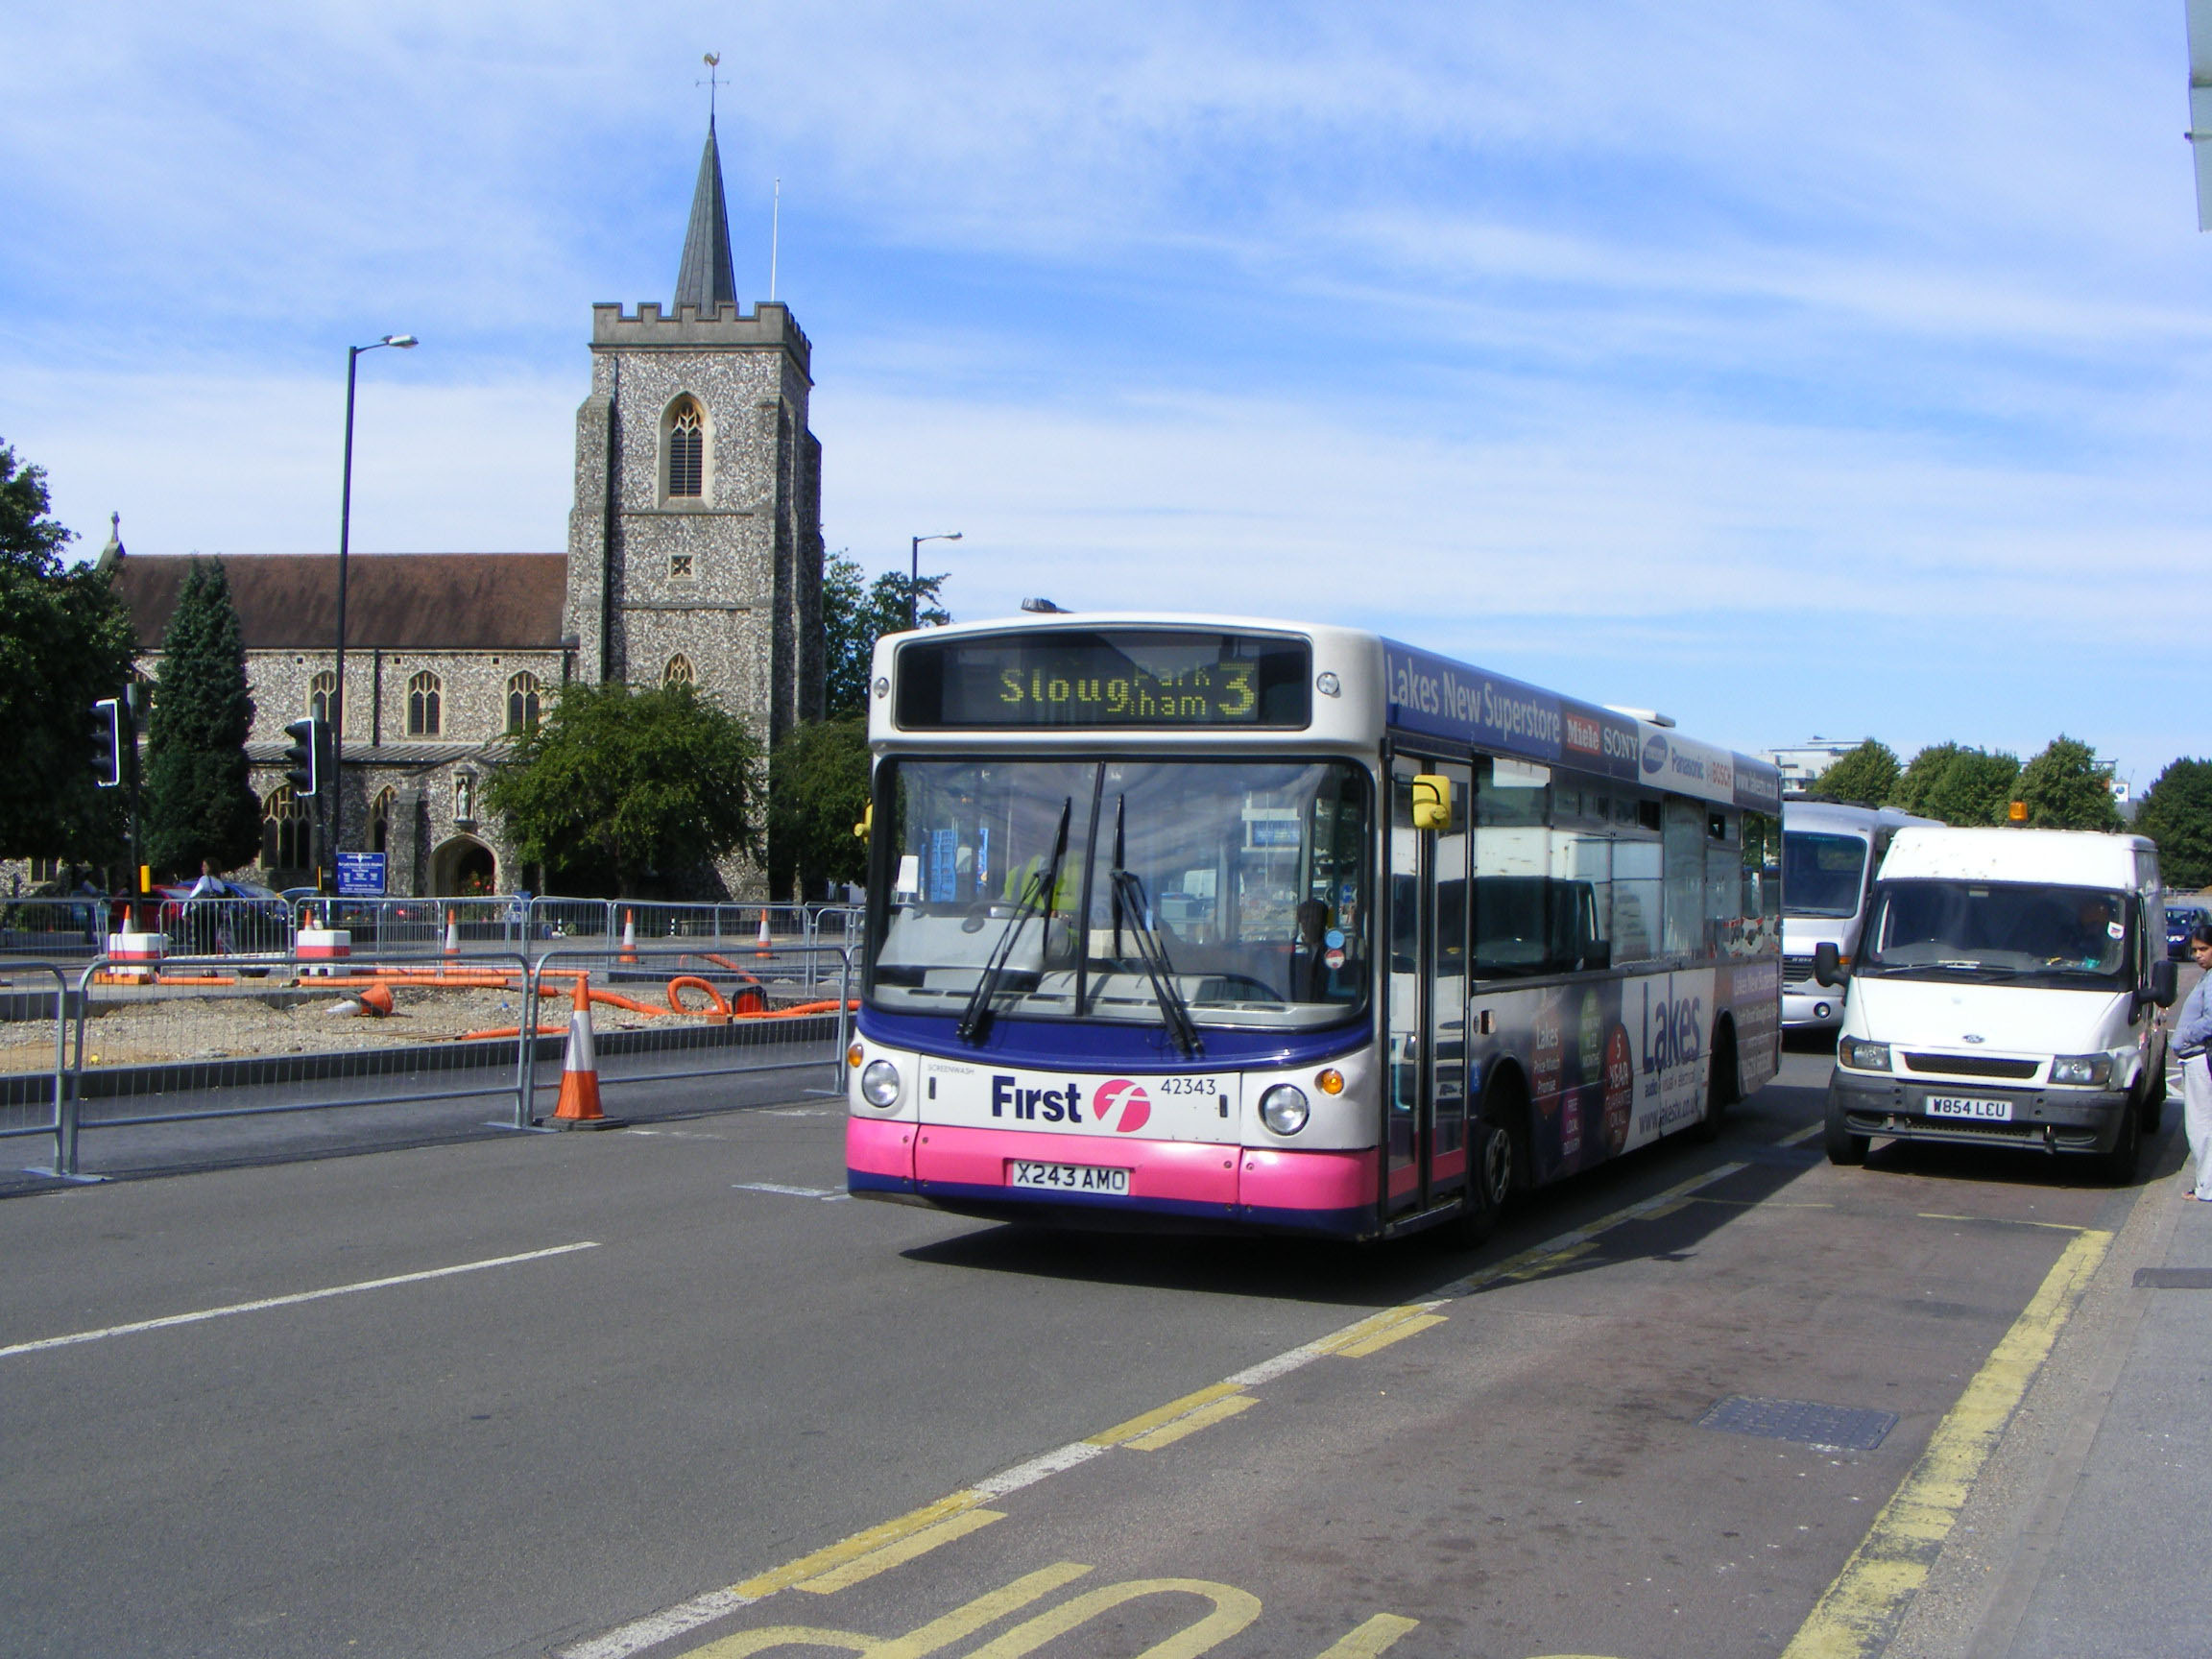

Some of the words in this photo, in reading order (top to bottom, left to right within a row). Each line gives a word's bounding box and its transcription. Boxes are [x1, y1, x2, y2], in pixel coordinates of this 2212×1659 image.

[1218, 661, 1256, 715] 3
[1387, 654, 1439, 715] Lakes
[1443, 671, 1480, 724] New
[1484, 683, 1560, 744] Superstore
[1567, 718, 1599, 752] Miele
[1603, 726, 1638, 761] SONY
[1671, 746, 1704, 781] Panasonic
[1713, 759, 1731, 786] BOSCH
[1536, 1022, 1558, 1050] Lakes
[1643, 973, 1700, 1074] Lakes
[1616, 1034, 1622, 1059] 5
[1160, 1078, 1216, 1095] 42343
[1609, 1061, 1628, 1089] YEAR
[992, 1075, 1082, 1123] First
[1934, 1098, 1971, 1115] W854
[1017, 1163, 1076, 1187] X243
[1082, 1169, 1125, 1190] AMO
